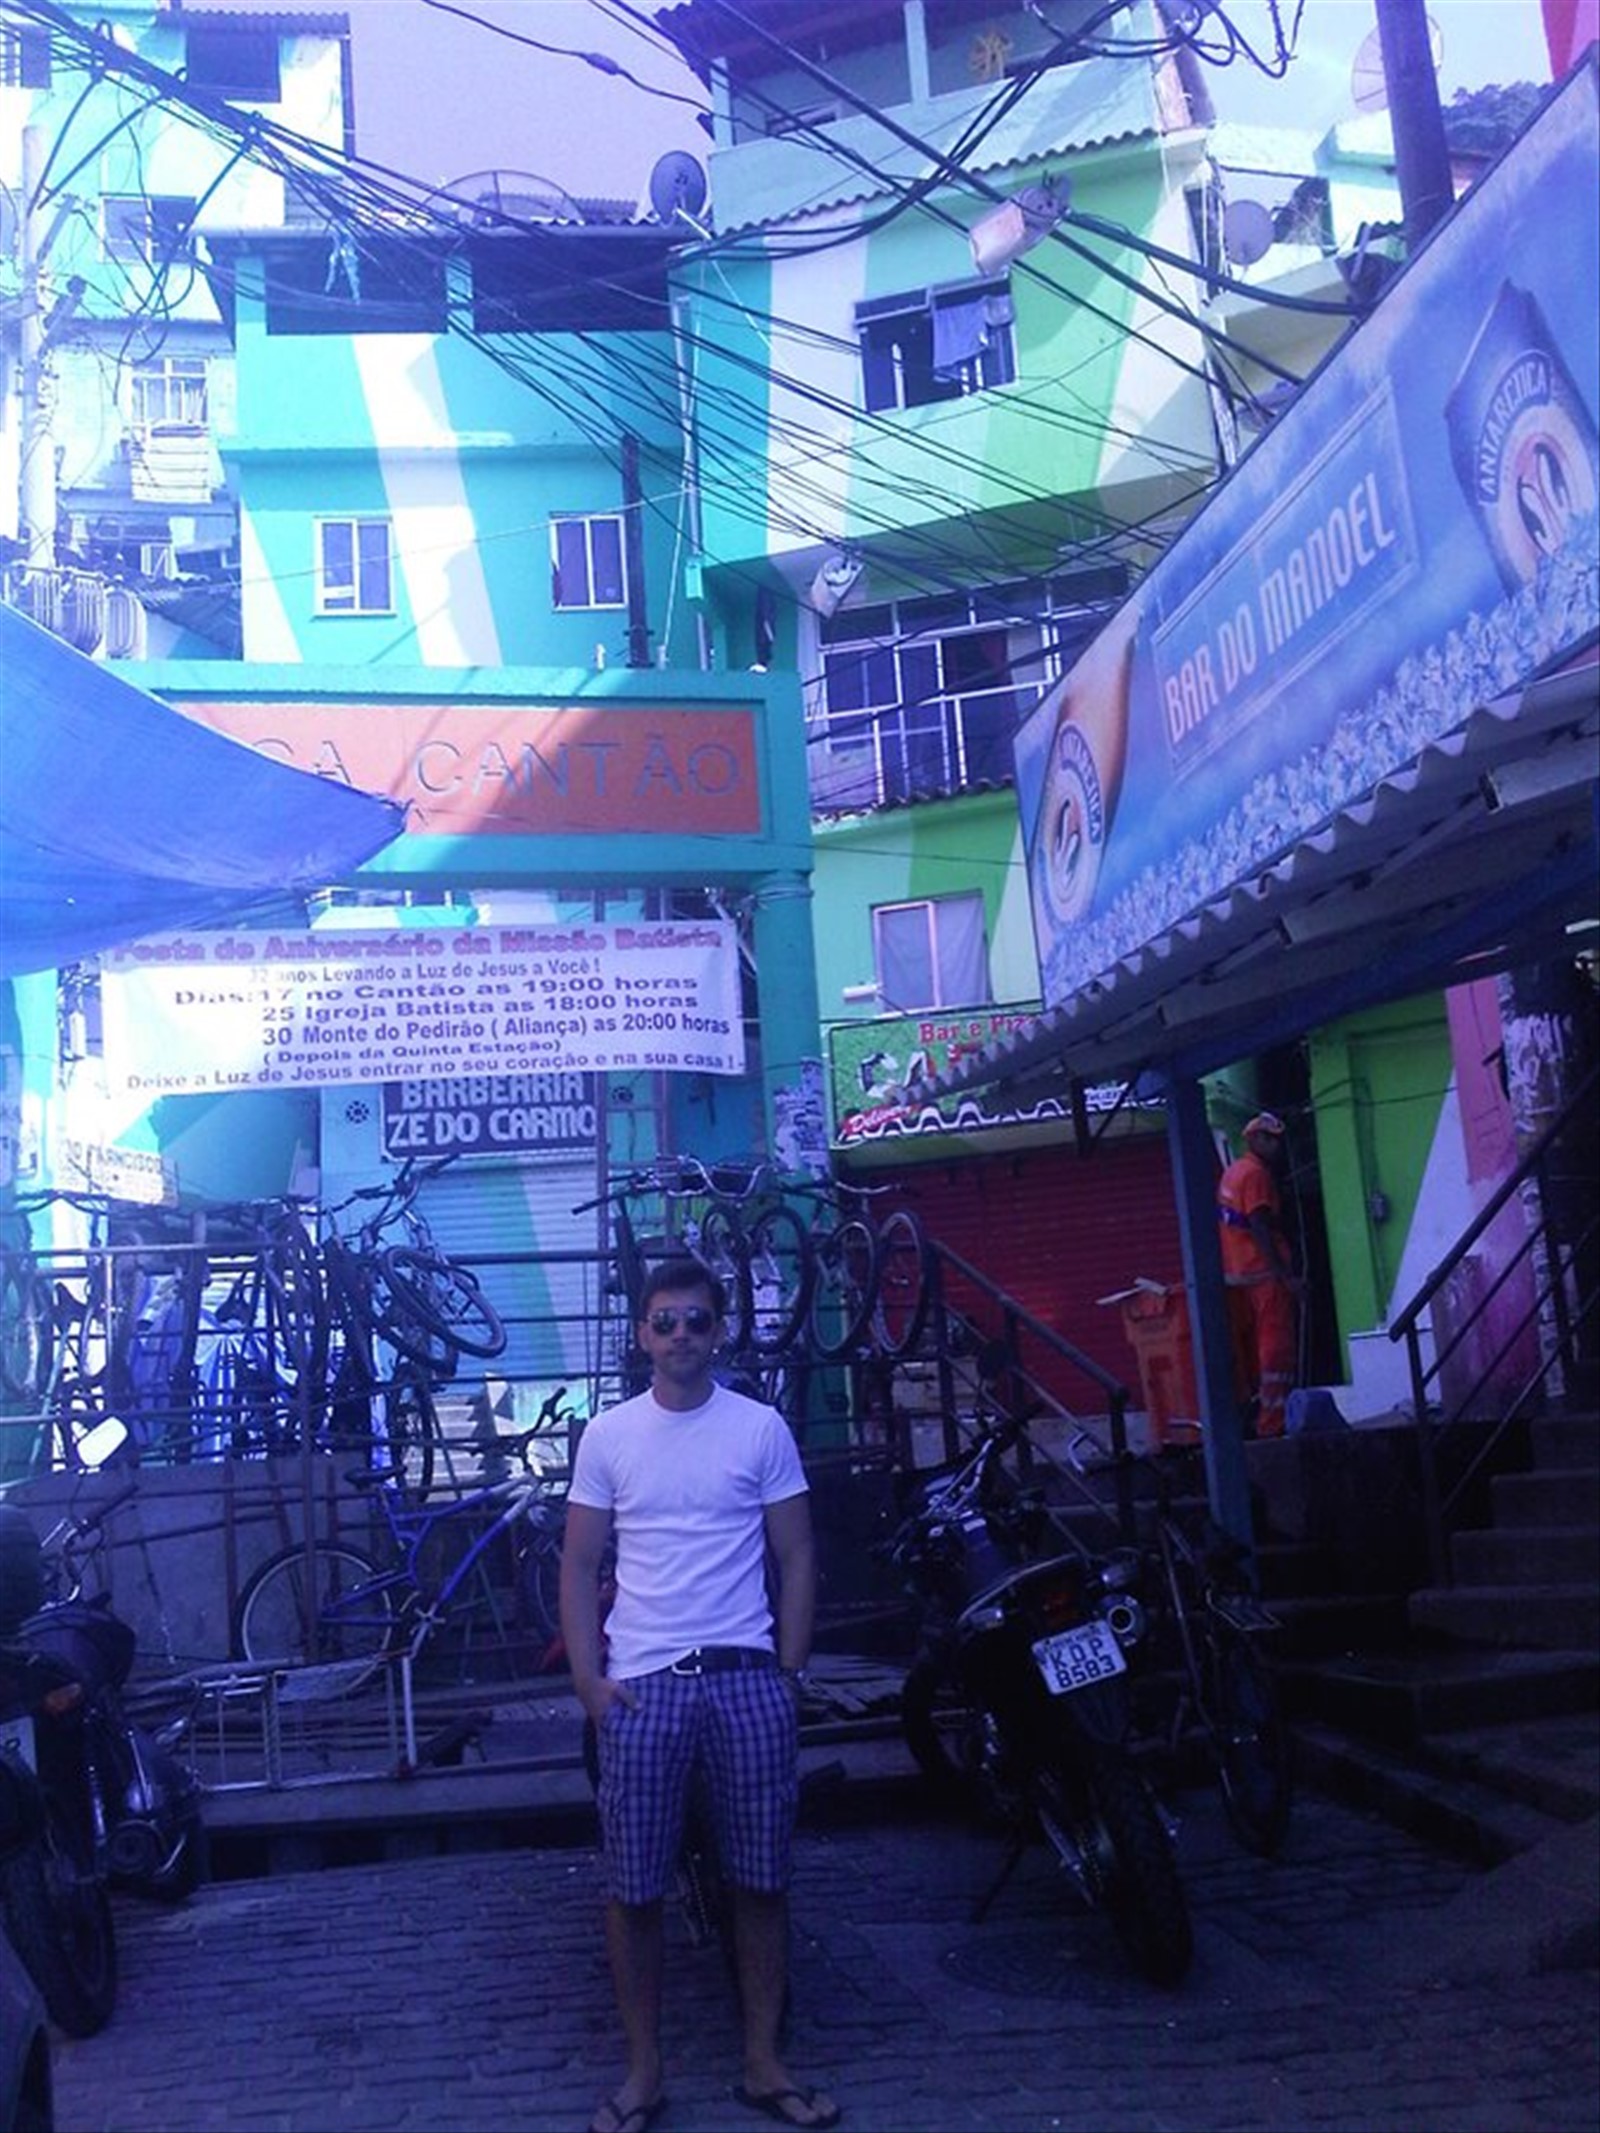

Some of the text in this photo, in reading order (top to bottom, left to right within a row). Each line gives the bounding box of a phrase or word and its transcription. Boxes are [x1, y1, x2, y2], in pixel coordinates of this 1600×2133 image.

[1479, 361, 1548, 495] ANTARCTICA
[1165, 472, 1396, 744] BAR DO MANOEL
[413, 732, 740, 797] CANTÃO
[263, 932, 444, 959] Aniversário
[453, 932, 492, 954] da
[501, 929, 606, 953] Missão
[615, 928, 722, 949] Batista
[323, 965, 396, 982] Levando
[401, 969, 412, 980] a
[417, 962, 447, 979] Luz
[452, 960, 472, 977] de
[477, 959, 528, 977] Jesus
[533, 963, 543, 975] a
[548, 957, 590, 974] Você
[306, 989, 343, 1000] no
[355, 981, 465, 999] Cantão
[476, 983, 511, 995] as
[523, 976, 604, 994] 19:00
[615, 976, 698, 991] horas
[262, 993, 698, 1023] 25 Igreja Batista as 18:00 horas
[263, 1026, 293, 1045] 30
[303, 1024, 368, 1044] Monte
[375, 1022, 400, 1041] do
[407, 1018, 485, 1039] Pedirão
[594, 1019, 617, 1032] as
[623, 1012, 676, 1031] 20:00
[682, 1013, 730, 1034] horas
[919, 1022, 960, 1042] Bar
[969, 1022, 981, 1037] e
[128, 1073, 186, 1089] Deixe
[194, 1075, 207, 1086] a
[215, 1069, 250, 1084] Luz
[258, 1066, 283, 1083] de
[290, 1064, 352, 1081] Jesus
[360, 1063, 423, 1078] entrar
[430, 1060, 456, 1073] no
[463, 1058, 498, 1071] seu
[505, 1052, 588, 1070] coração
[595, 1054, 607, 1066] e
[613, 1053, 638, 1065] na
[644, 1053, 678, 1065] sua
[684, 1054, 723, 1069] casa
[278, 1050, 352, 1064] Depois
[359, 1047, 385, 1060] da
[393, 1044, 462, 1058] Quinta
[402, 1072, 584, 1109] BARBEARIA
[435, 1111, 480, 1145] DO
[489, 1106, 597, 1141] CARMO
[1056, 1655, 1115, 1688] 8583
